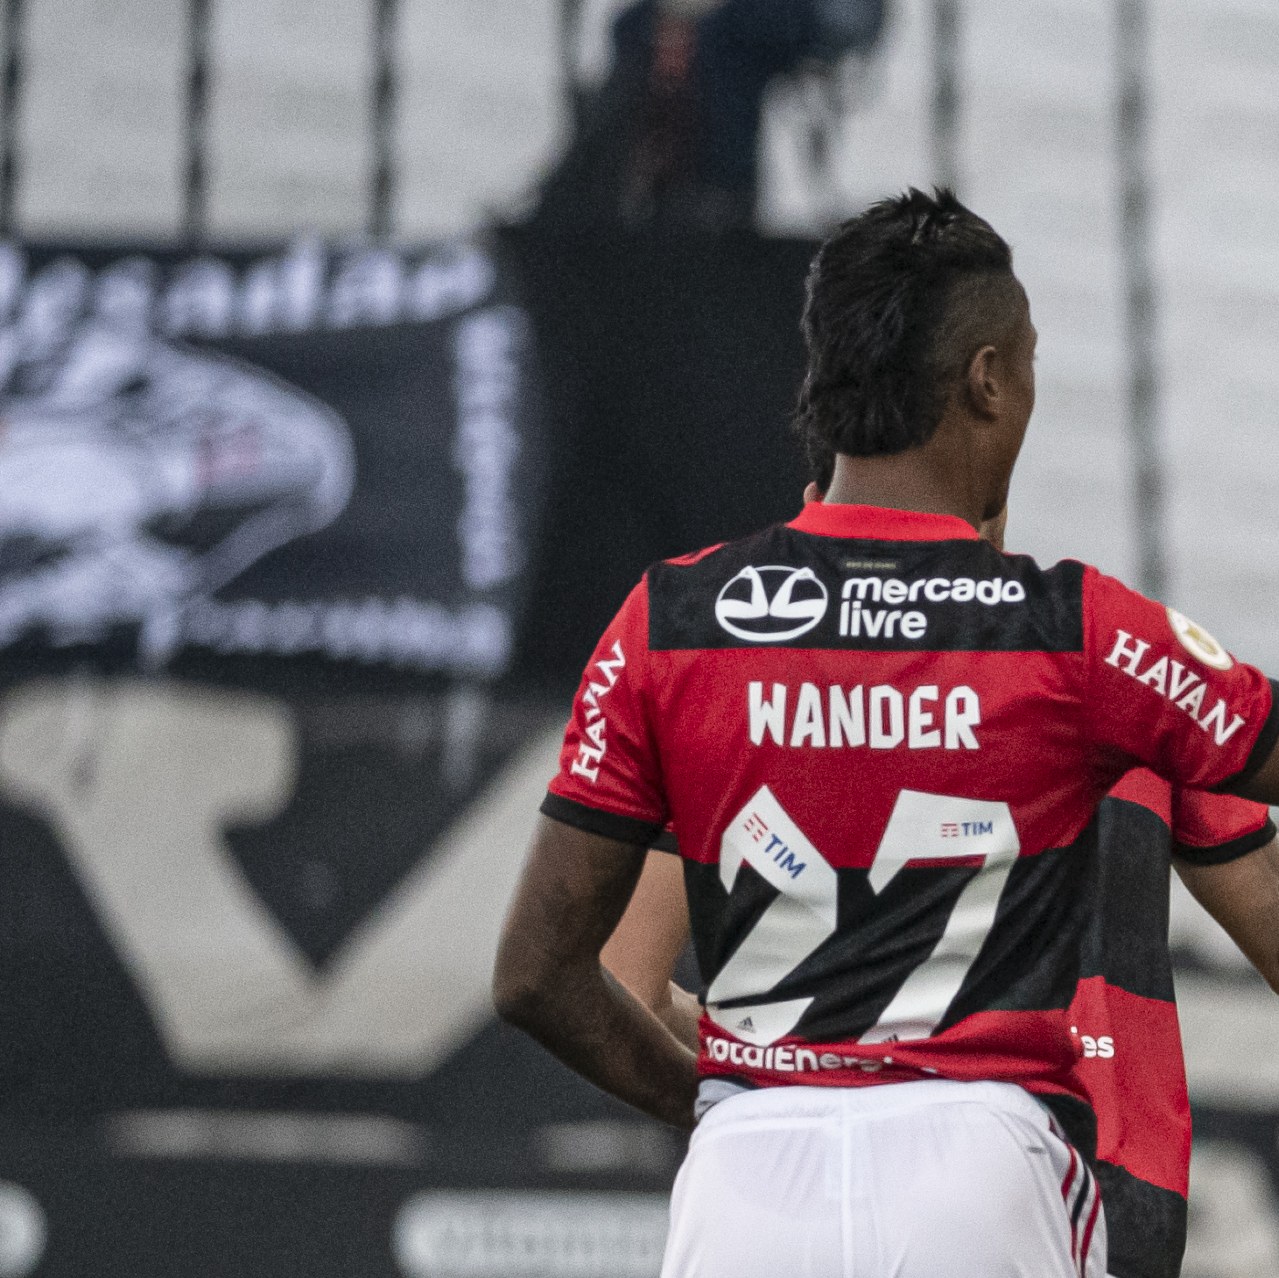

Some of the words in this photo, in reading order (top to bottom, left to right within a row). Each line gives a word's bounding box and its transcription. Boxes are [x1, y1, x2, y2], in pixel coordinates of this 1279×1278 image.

[841, 576, 1026, 606] mercado
[839, 605, 928, 638] livre
[571, 640, 626, 782] HAVAN
[747, 680, 982, 750] WANDER
[1105, 630, 1246, 746] HAVAN
[764, 834, 807, 880] TIM
[961, 821, 994, 838] TIM
[706, 784, 1020, 1047] 27
